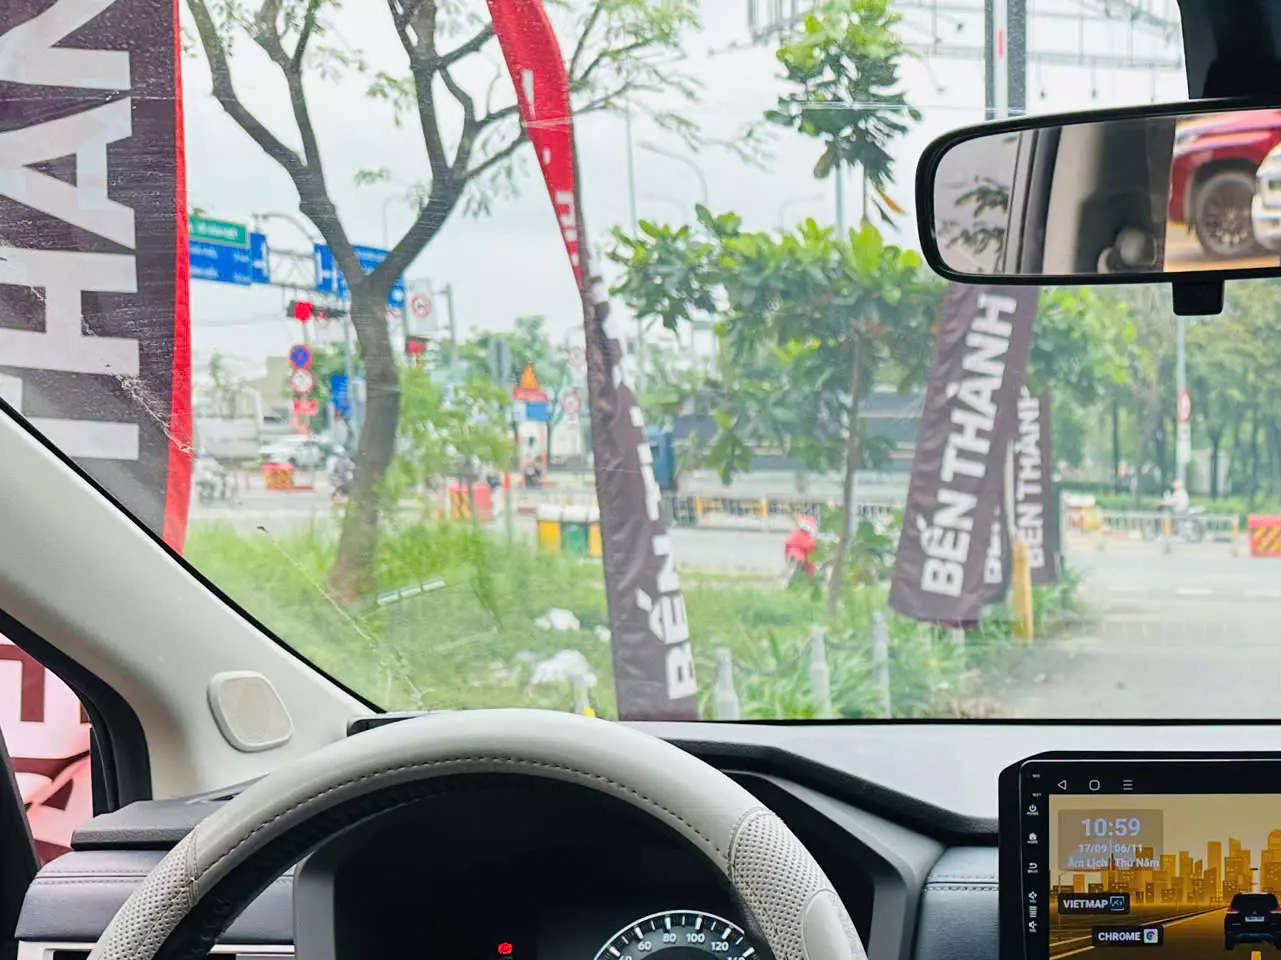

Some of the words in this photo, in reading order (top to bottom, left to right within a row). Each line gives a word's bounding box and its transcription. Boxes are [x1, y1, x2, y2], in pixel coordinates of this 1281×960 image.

[941, 293, 1017, 483] THÀNH
[916, 487, 978, 597] BẾN
[1081, 817, 1141, 837] 10:59
[1078, 843, 1108, 853] 17/09
[1114, 843, 1143, 853] 06/11
[1063, 900, 1109, 909] VIETMAP
[662, 933, 677, 943] 80
[686, 933, 705, 943] 100
[1098, 932, 1141, 941] CHROME
[637, 941, 652, 951] 60
[711, 941, 729, 951] 120
